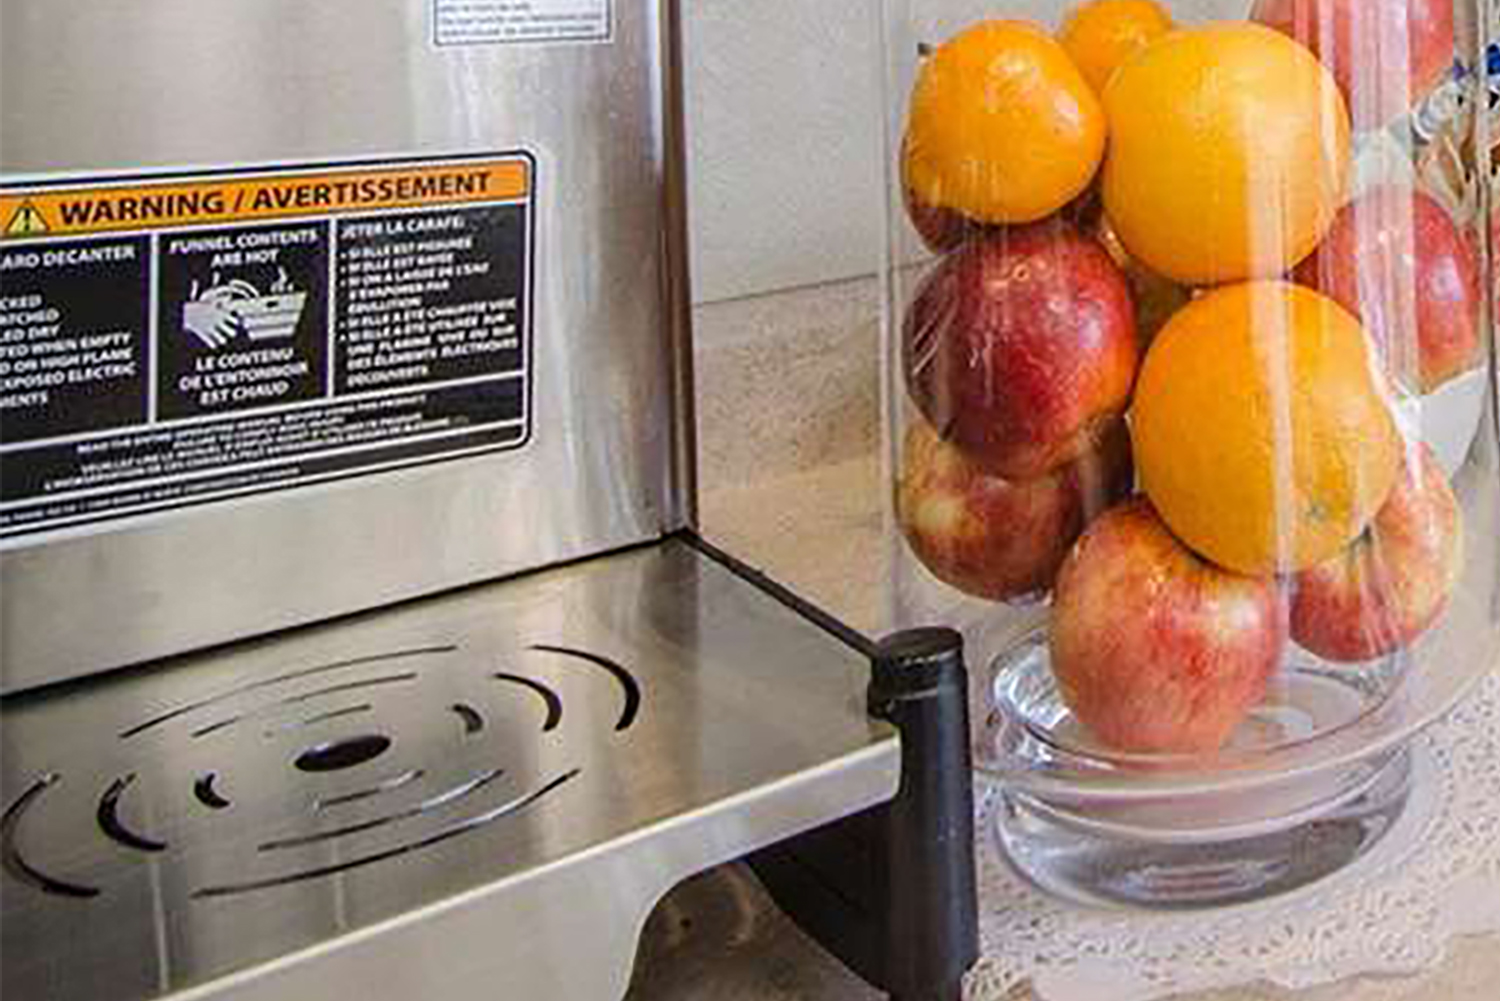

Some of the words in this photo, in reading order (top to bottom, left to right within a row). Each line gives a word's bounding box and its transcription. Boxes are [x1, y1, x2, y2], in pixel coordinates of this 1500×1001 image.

[59, 187, 226, 225] WARNING
[253, 171, 492, 213] AVERTISSEMENT
[170, 236, 234, 255] FUNNEL
[236, 229, 318, 250] CONTENTS
[43, 244, 136, 268] DECANTER
[211, 252, 242, 268] ARE
[245, 249, 280, 265] HOT
[196, 356, 216, 373] LE
[218, 348, 295, 370] CONTENU
[200, 387, 231, 406] EST
[232, 380, 290, 402] CHAUD
